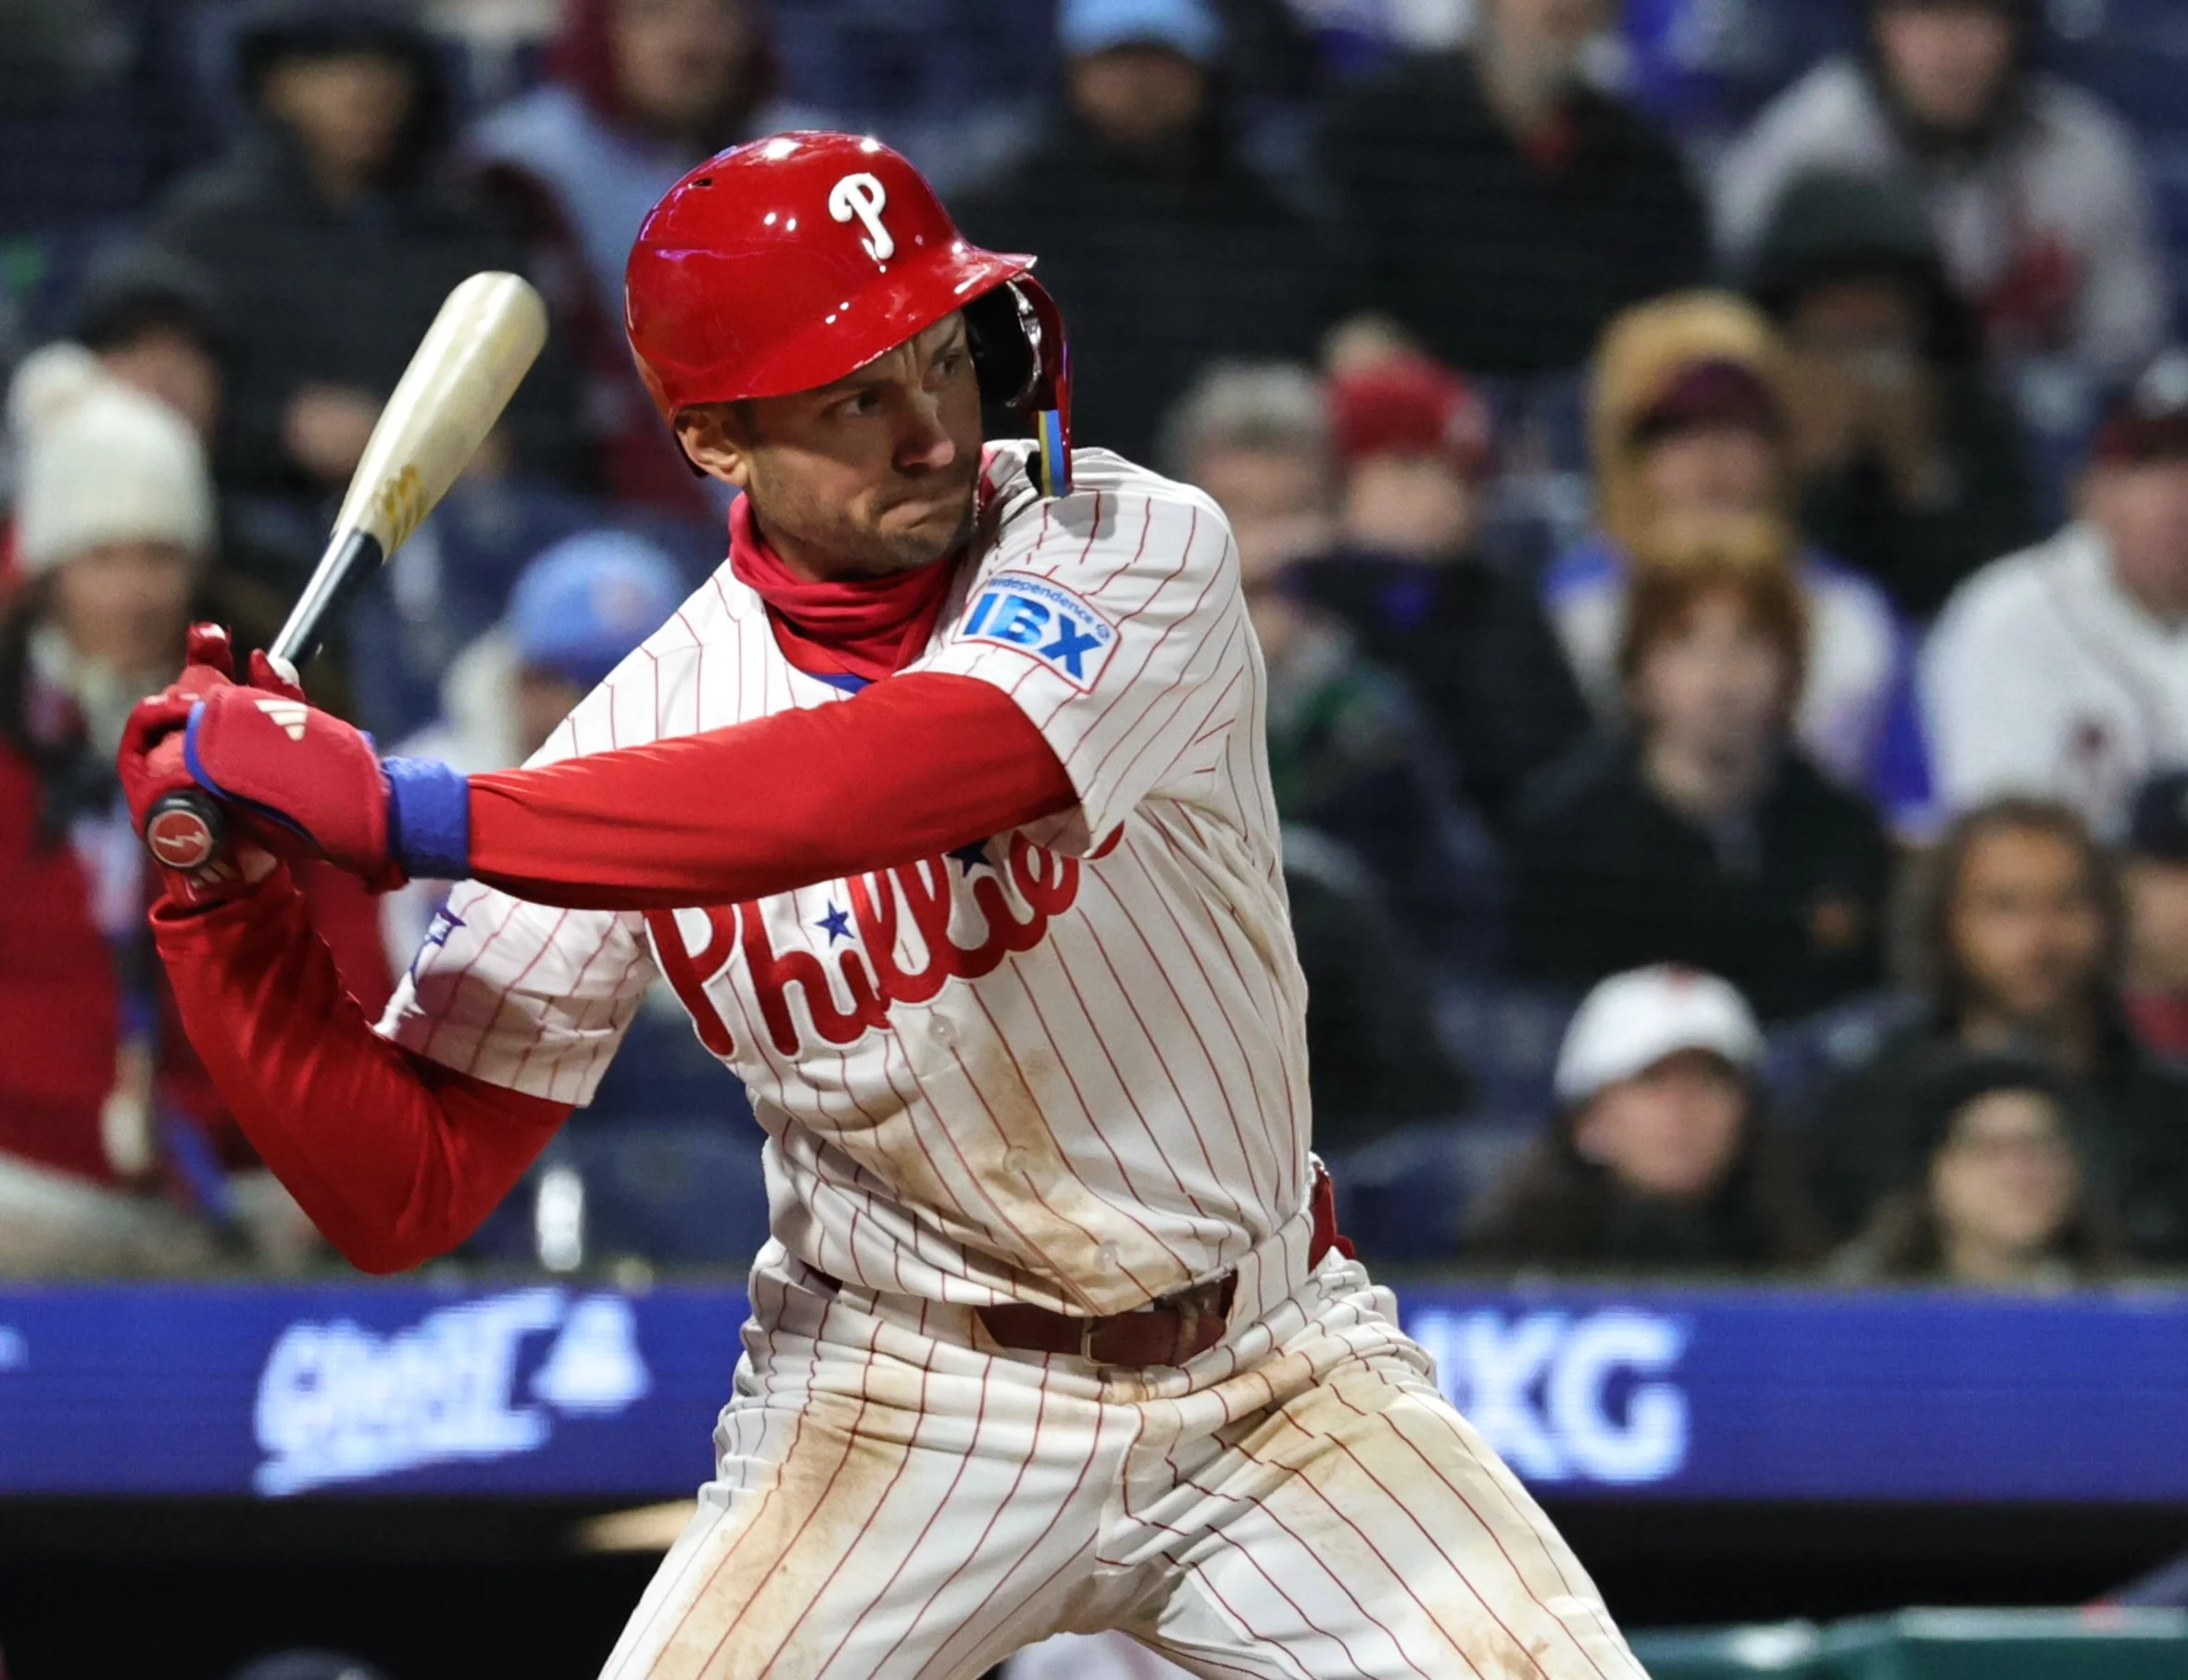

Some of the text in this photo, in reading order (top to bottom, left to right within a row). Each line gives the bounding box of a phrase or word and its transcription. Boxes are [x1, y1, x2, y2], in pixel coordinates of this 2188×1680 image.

[829, 172, 895, 260] P
[962, 592, 1103, 681] IBX
[646, 819, 1125, 1059] Phillie
